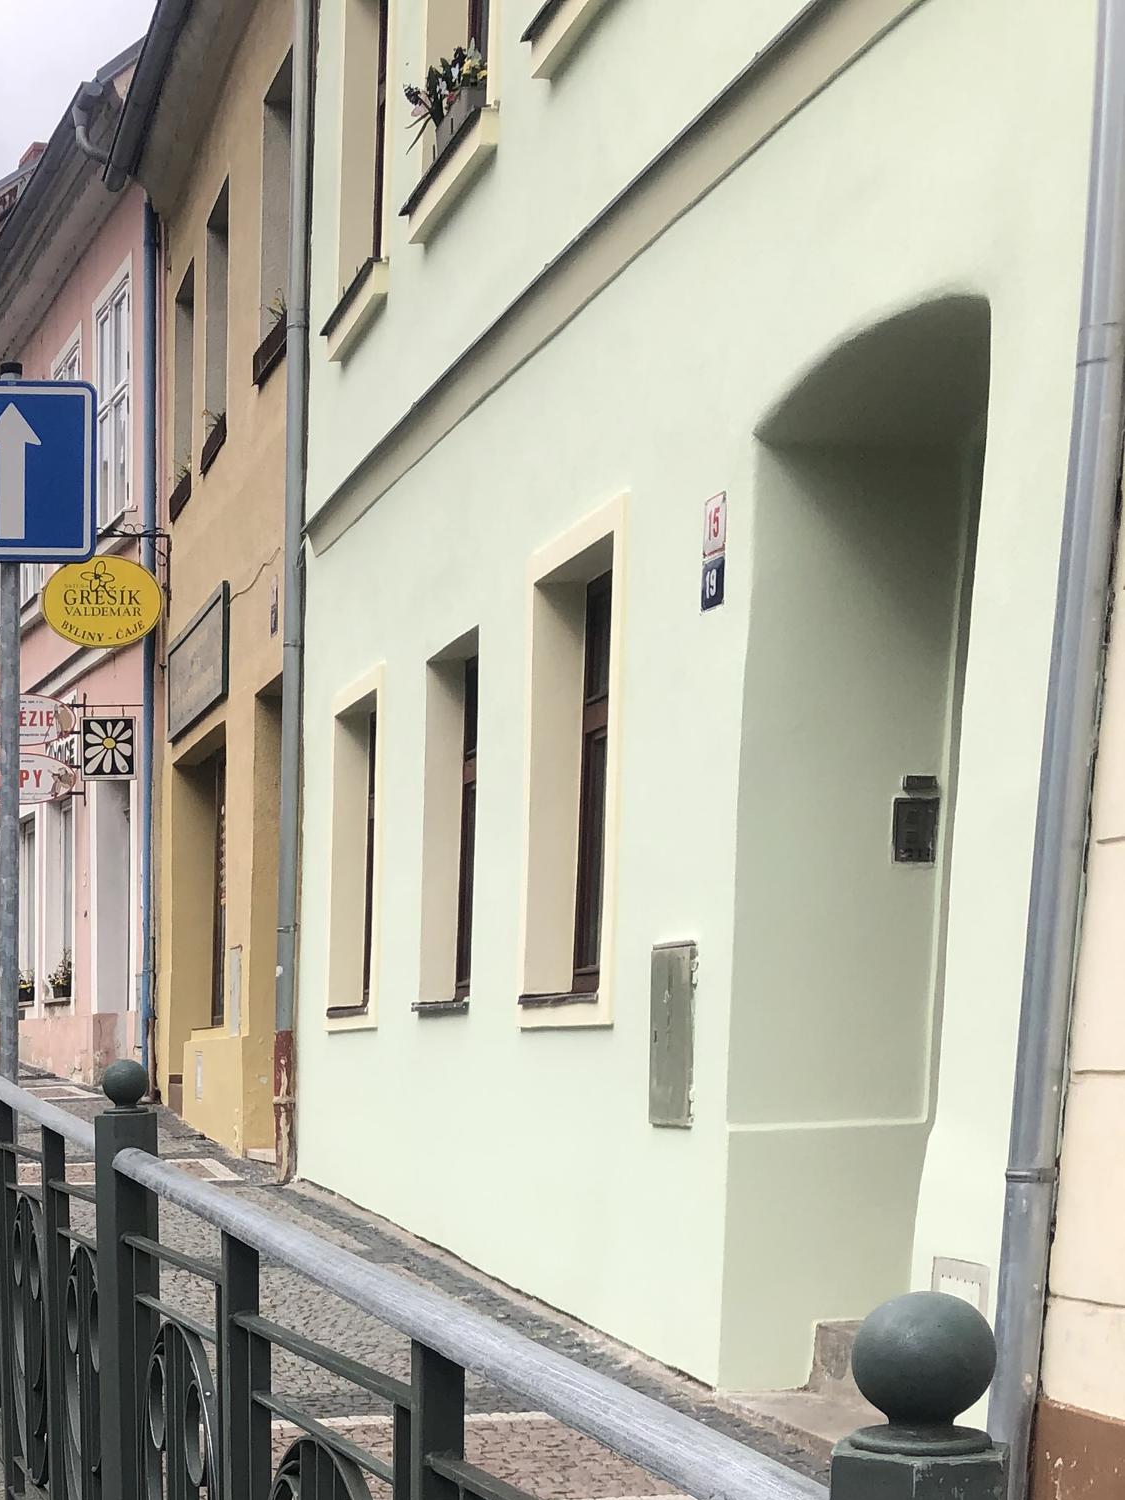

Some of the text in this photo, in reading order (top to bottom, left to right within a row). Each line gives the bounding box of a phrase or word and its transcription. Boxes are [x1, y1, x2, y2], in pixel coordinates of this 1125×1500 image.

[708, 507, 720, 541] 15
[706, 568, 717, 599] 19
[64, 606, 142, 617] VALDEMAR
[61, 620, 104, 642] BYLINY
[116, 620, 145, 640] ČAJE
